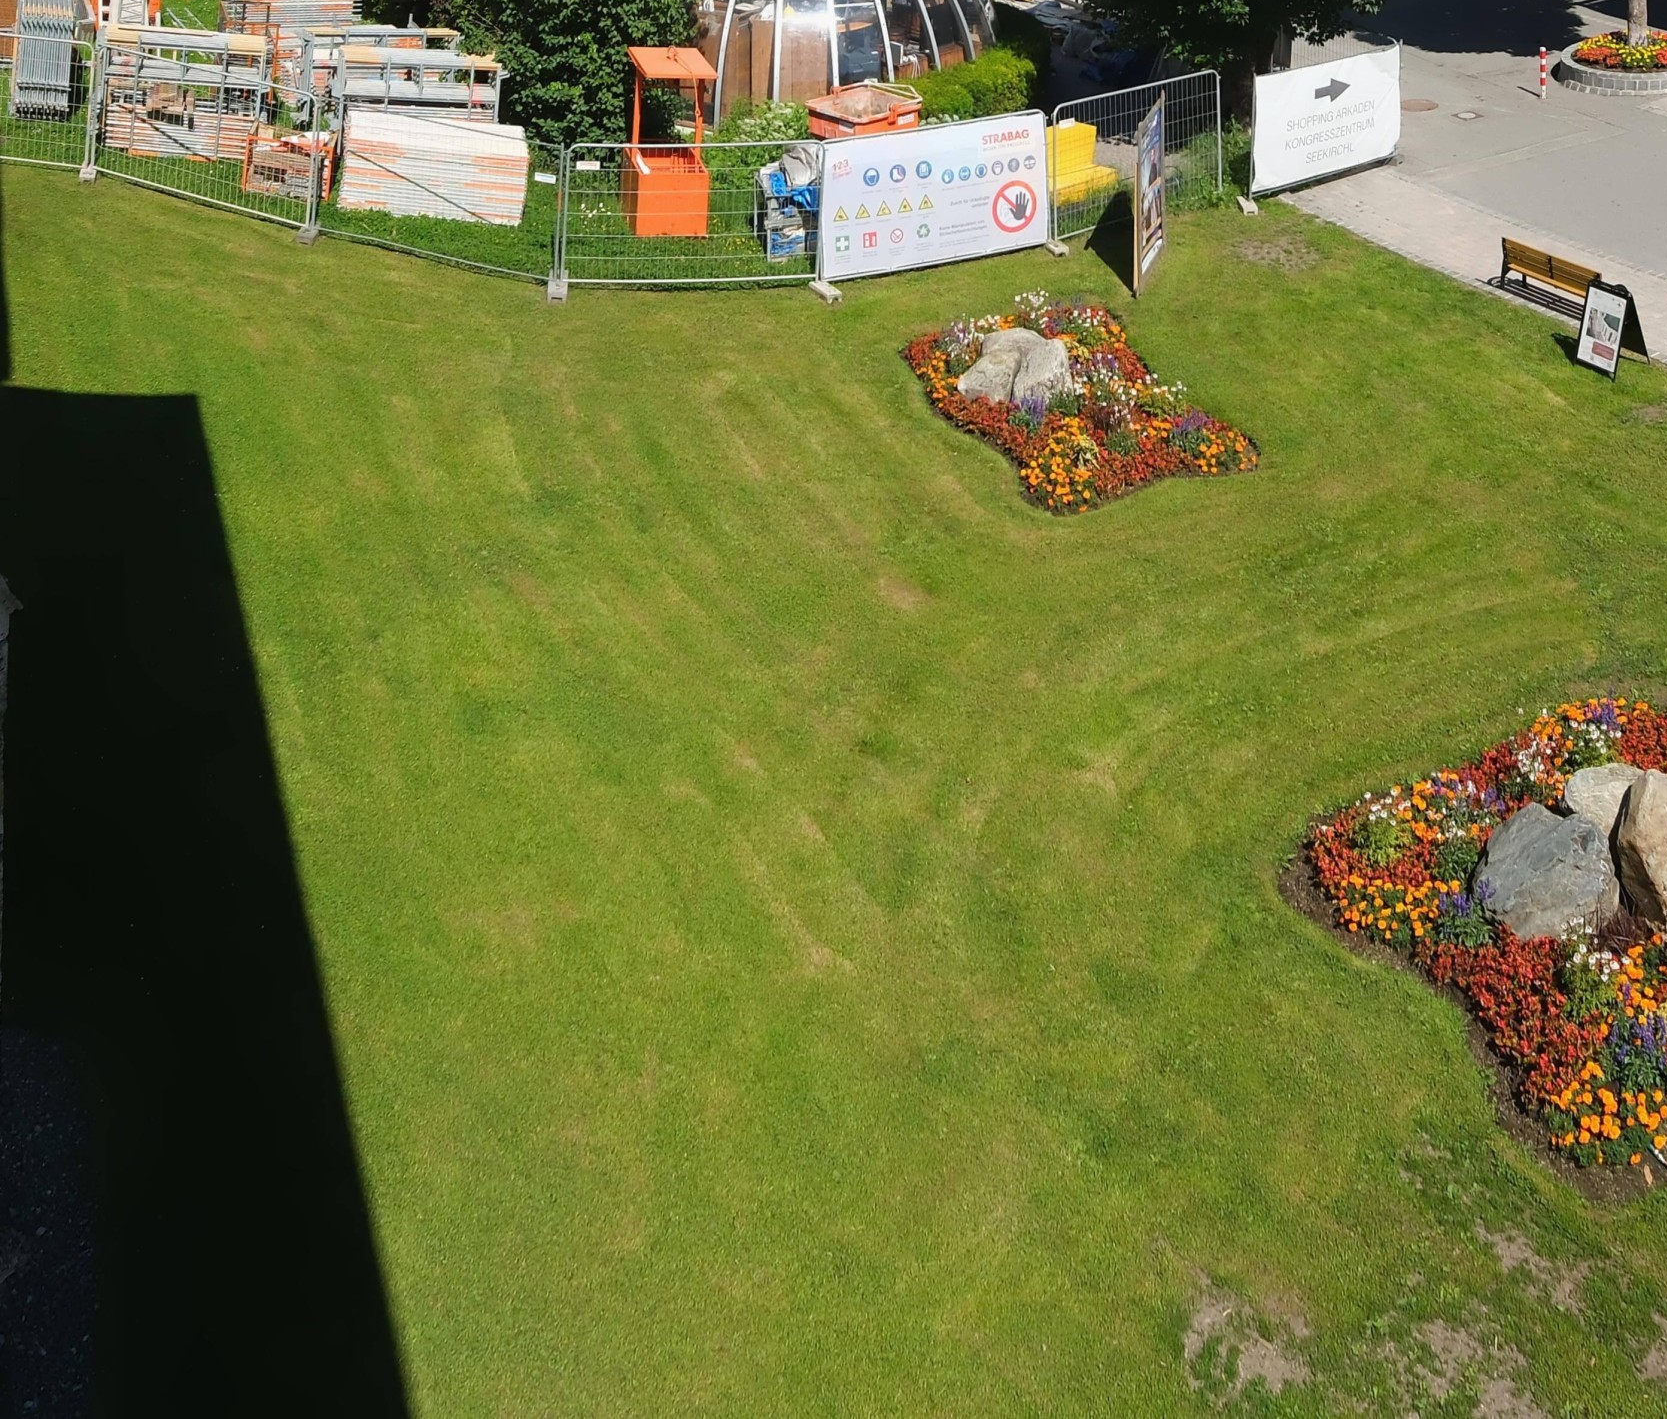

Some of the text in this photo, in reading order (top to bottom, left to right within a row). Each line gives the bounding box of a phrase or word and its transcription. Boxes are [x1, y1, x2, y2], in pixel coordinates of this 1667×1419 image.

[1286, 100, 1375, 132] SHOPPING ARKADEN
[982, 129, 1030, 145] STRABAG
[1285, 117, 1375, 151] KONGRESSZENTRUM
[1305, 142, 1355, 164] SEEKIRCHL
